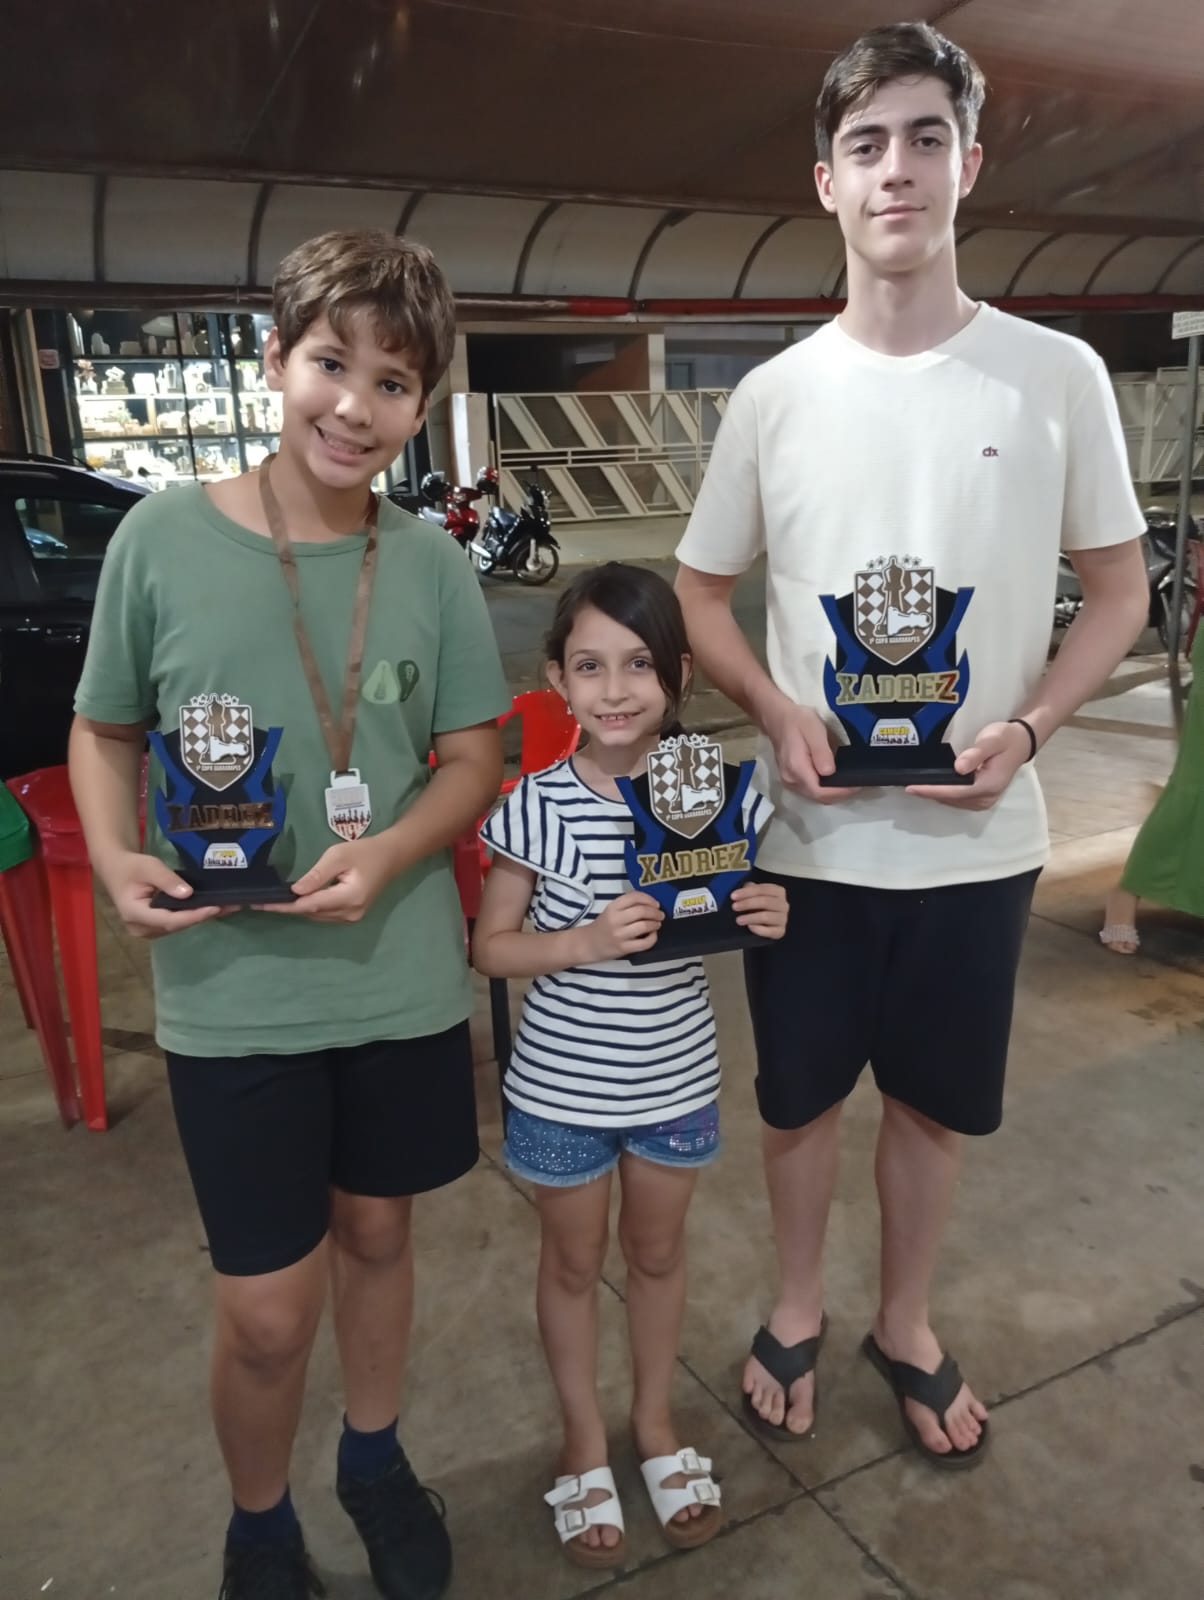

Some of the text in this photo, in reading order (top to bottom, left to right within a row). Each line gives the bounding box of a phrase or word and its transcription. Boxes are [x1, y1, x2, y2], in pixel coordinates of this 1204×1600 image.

[982, 446, 999, 457] dx
[836, 669, 959, 706] XADREZ
[166, 802, 275, 832] XADREZ
[637, 839, 751, 886] XADREZ
